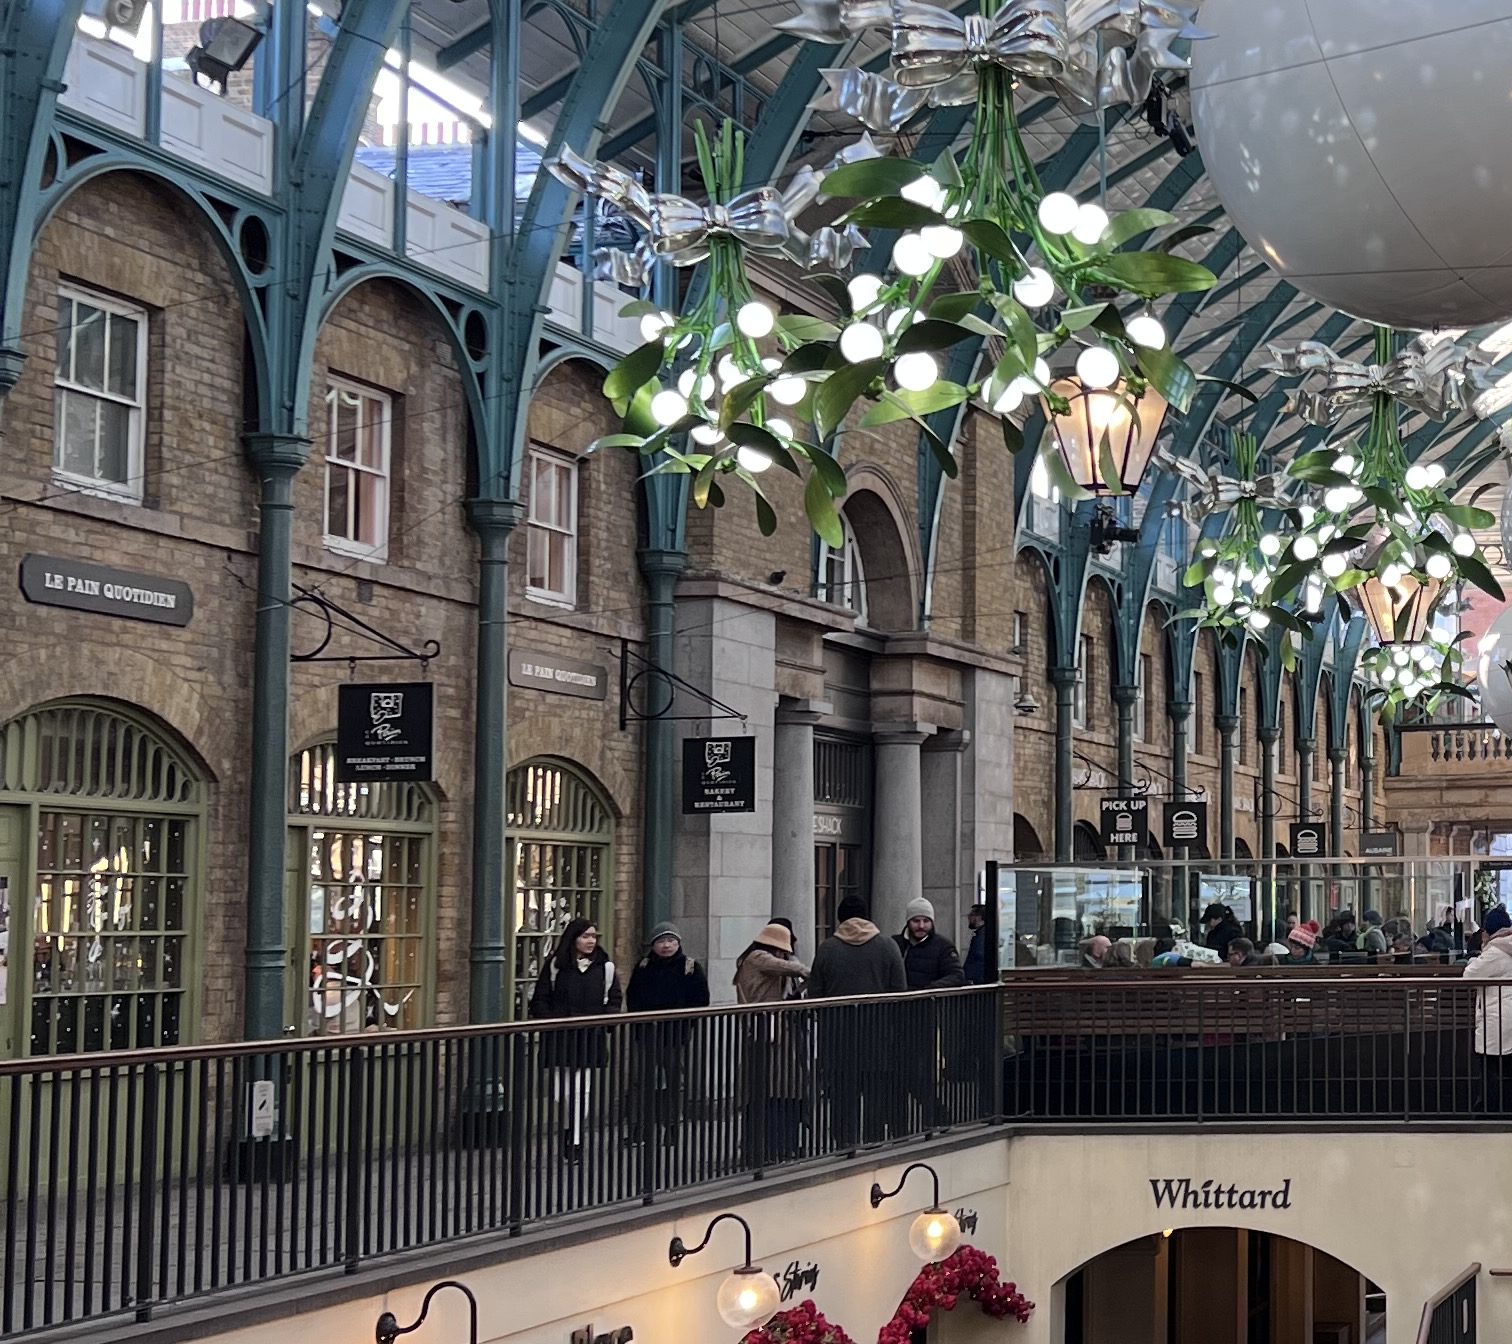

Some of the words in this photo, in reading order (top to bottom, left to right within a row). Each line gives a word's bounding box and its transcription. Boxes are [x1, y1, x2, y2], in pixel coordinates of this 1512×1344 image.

[44, 572, 64, 590] LE
[67, 576, 101, 596] PAIN
[103, 583, 177, 609] QUOTIDIEN
[534, 665, 554, 679] PAIN
[1102, 800, 1127, 811] PICK
[1131, 800, 1147, 810] UP
[1110, 832, 1138, 843] HERE
[1149, 1178, 1292, 1209] Whittard
